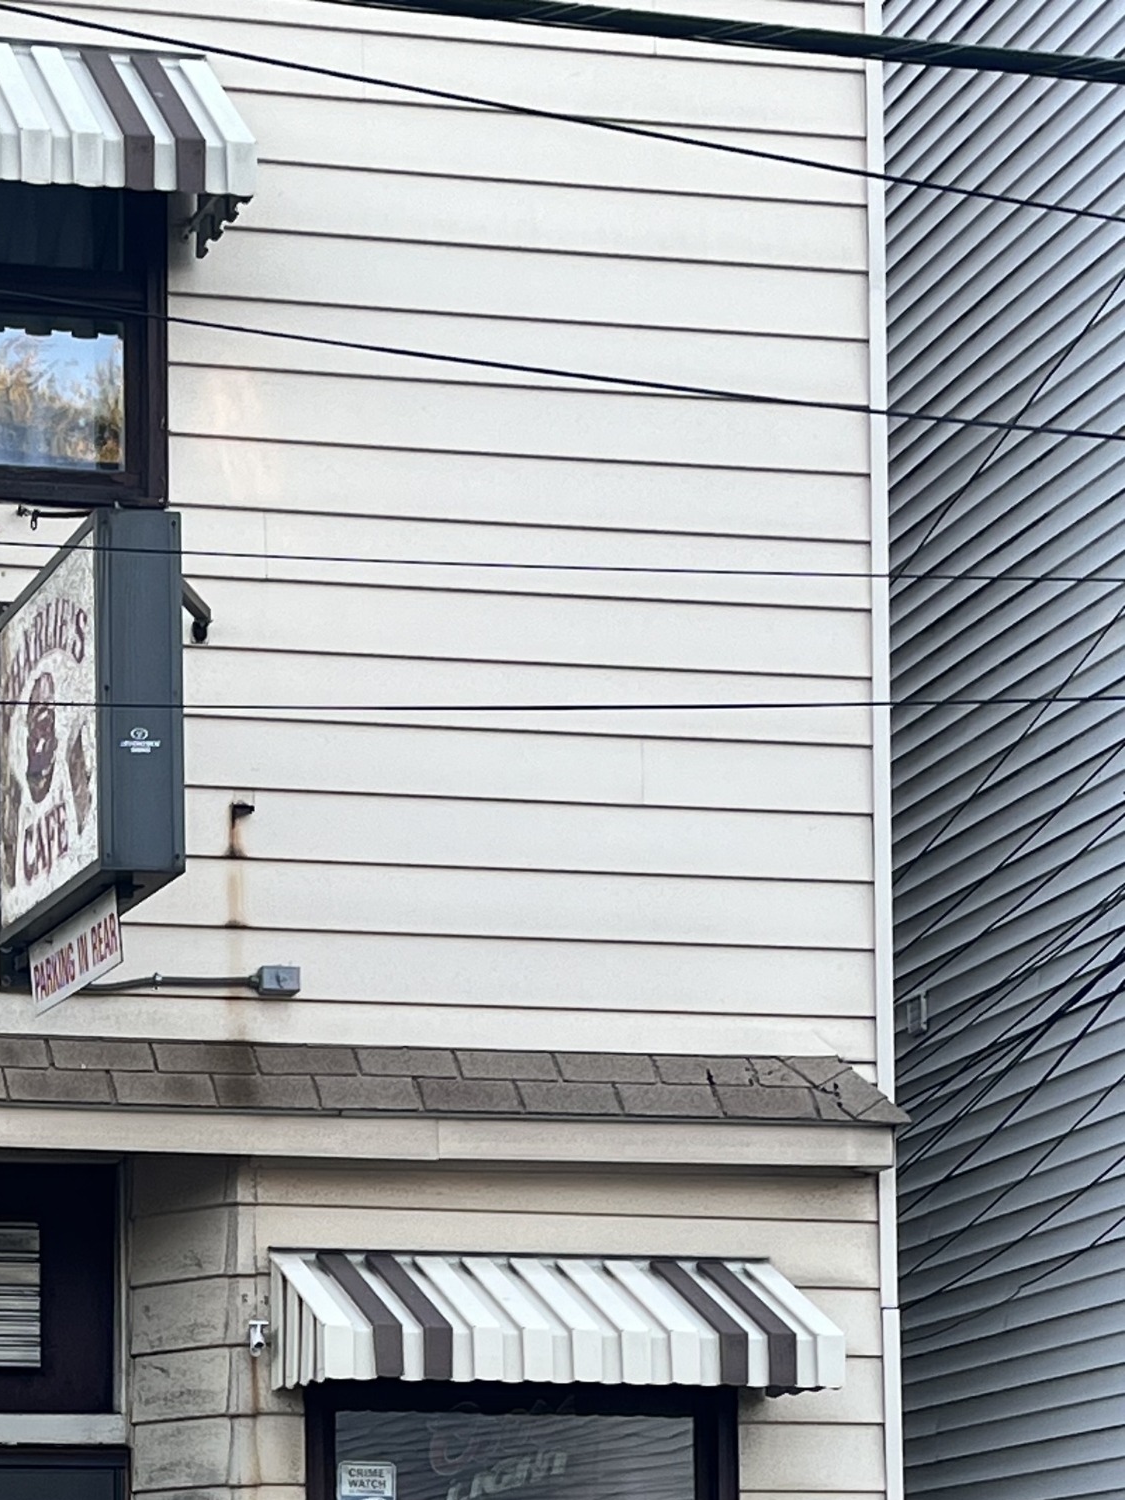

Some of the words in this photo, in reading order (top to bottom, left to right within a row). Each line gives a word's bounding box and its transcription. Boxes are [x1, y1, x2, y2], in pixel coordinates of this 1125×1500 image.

[23, 803, 68, 882] CAFE
[33, 943, 75, 999] PARKING
[77, 931, 89, 976] IN
[91, 912, 118, 968] REAR
[348, 1468, 385, 1478] CRIME
[348, 1479, 387, 1489] WATCH
